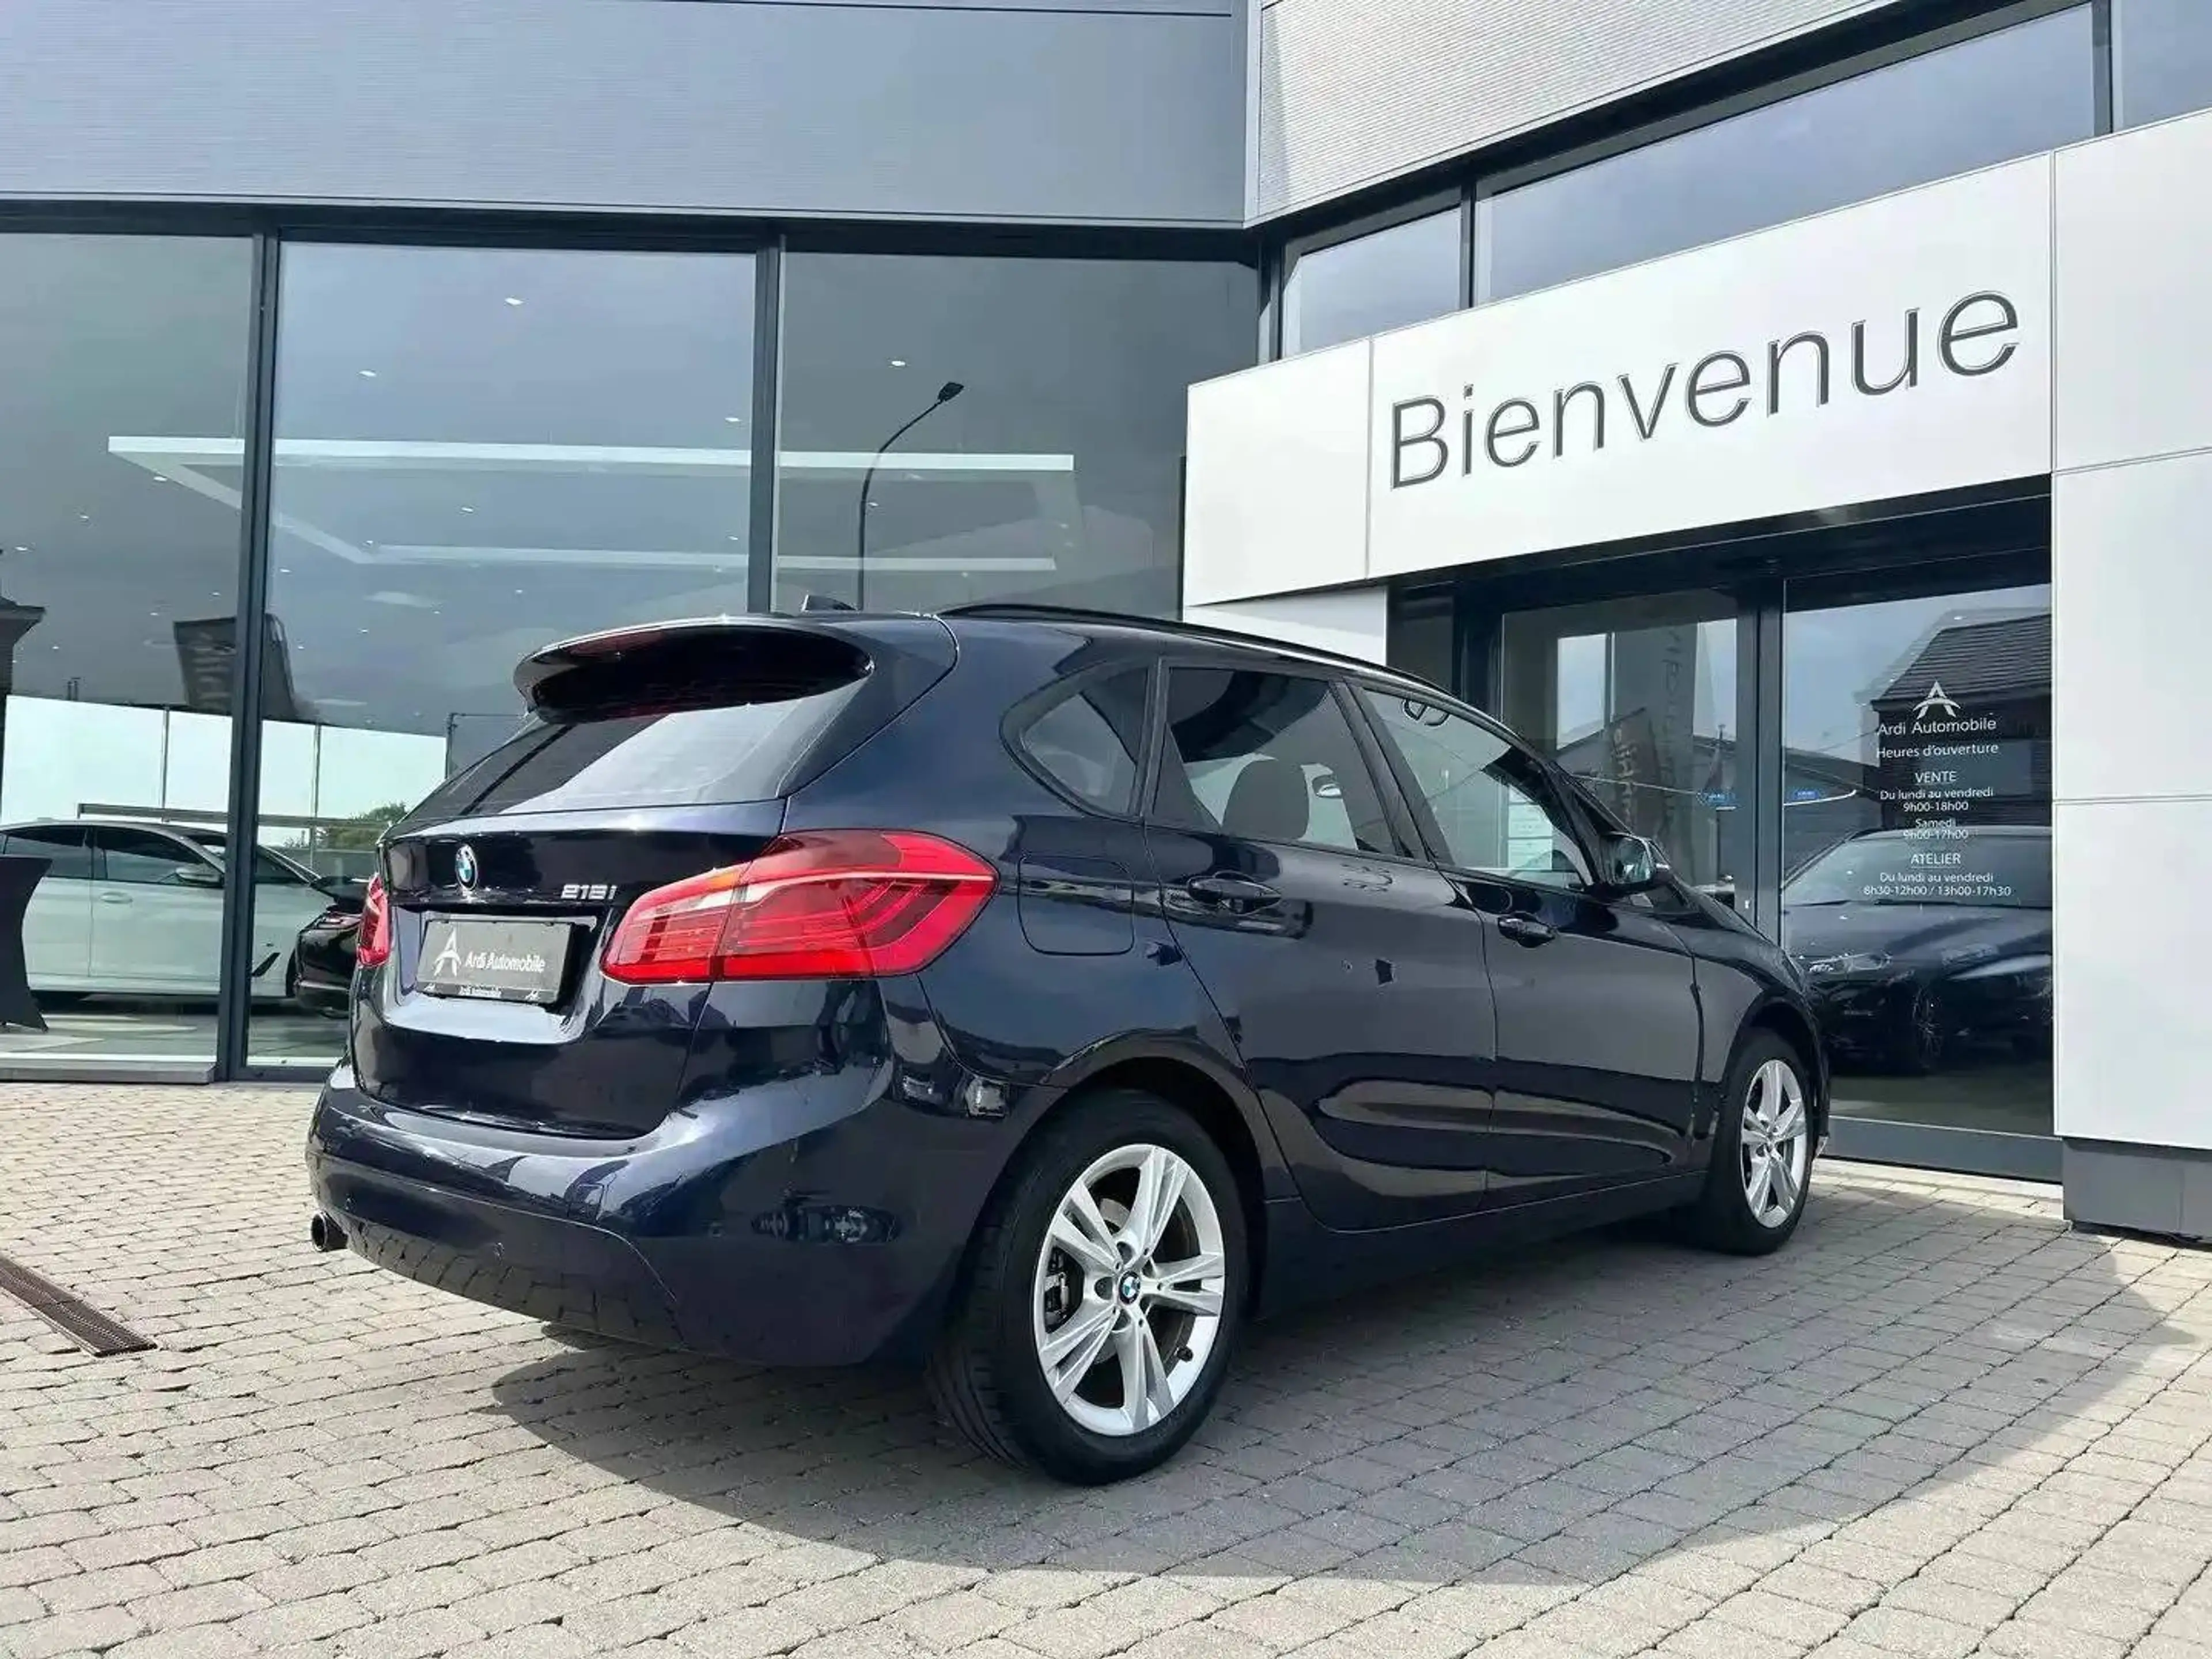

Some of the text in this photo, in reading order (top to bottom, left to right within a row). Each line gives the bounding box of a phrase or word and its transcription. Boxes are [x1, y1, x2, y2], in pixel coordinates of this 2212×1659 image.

[1389, 290, 2020, 490] Bienvenue
[1877, 718, 1997, 736] Ardi Automobile
[1876, 744, 1999, 759] Heures d'ouverture
[1915, 771, 1957, 785] VENTE
[1880, 790, 1895, 800] Du
[1899, 789, 1926, 799] lundi
[1944, 787, 1994, 798] vendredi
[1903, 801, 1969, 812] 9h00-18h00
[1915, 817, 1956, 828] Samedi
[1910, 853, 1961, 866] ATELIER
[1880, 872, 1994, 882] Du lundi au vendredi
[560, 884, 617, 900] 218i
[1863, 886, 1927, 896] 8h30-12h00
[1938, 885, 2012, 896] 13h00-17h30
[465, 951, 546, 974] Ardi Automobile
